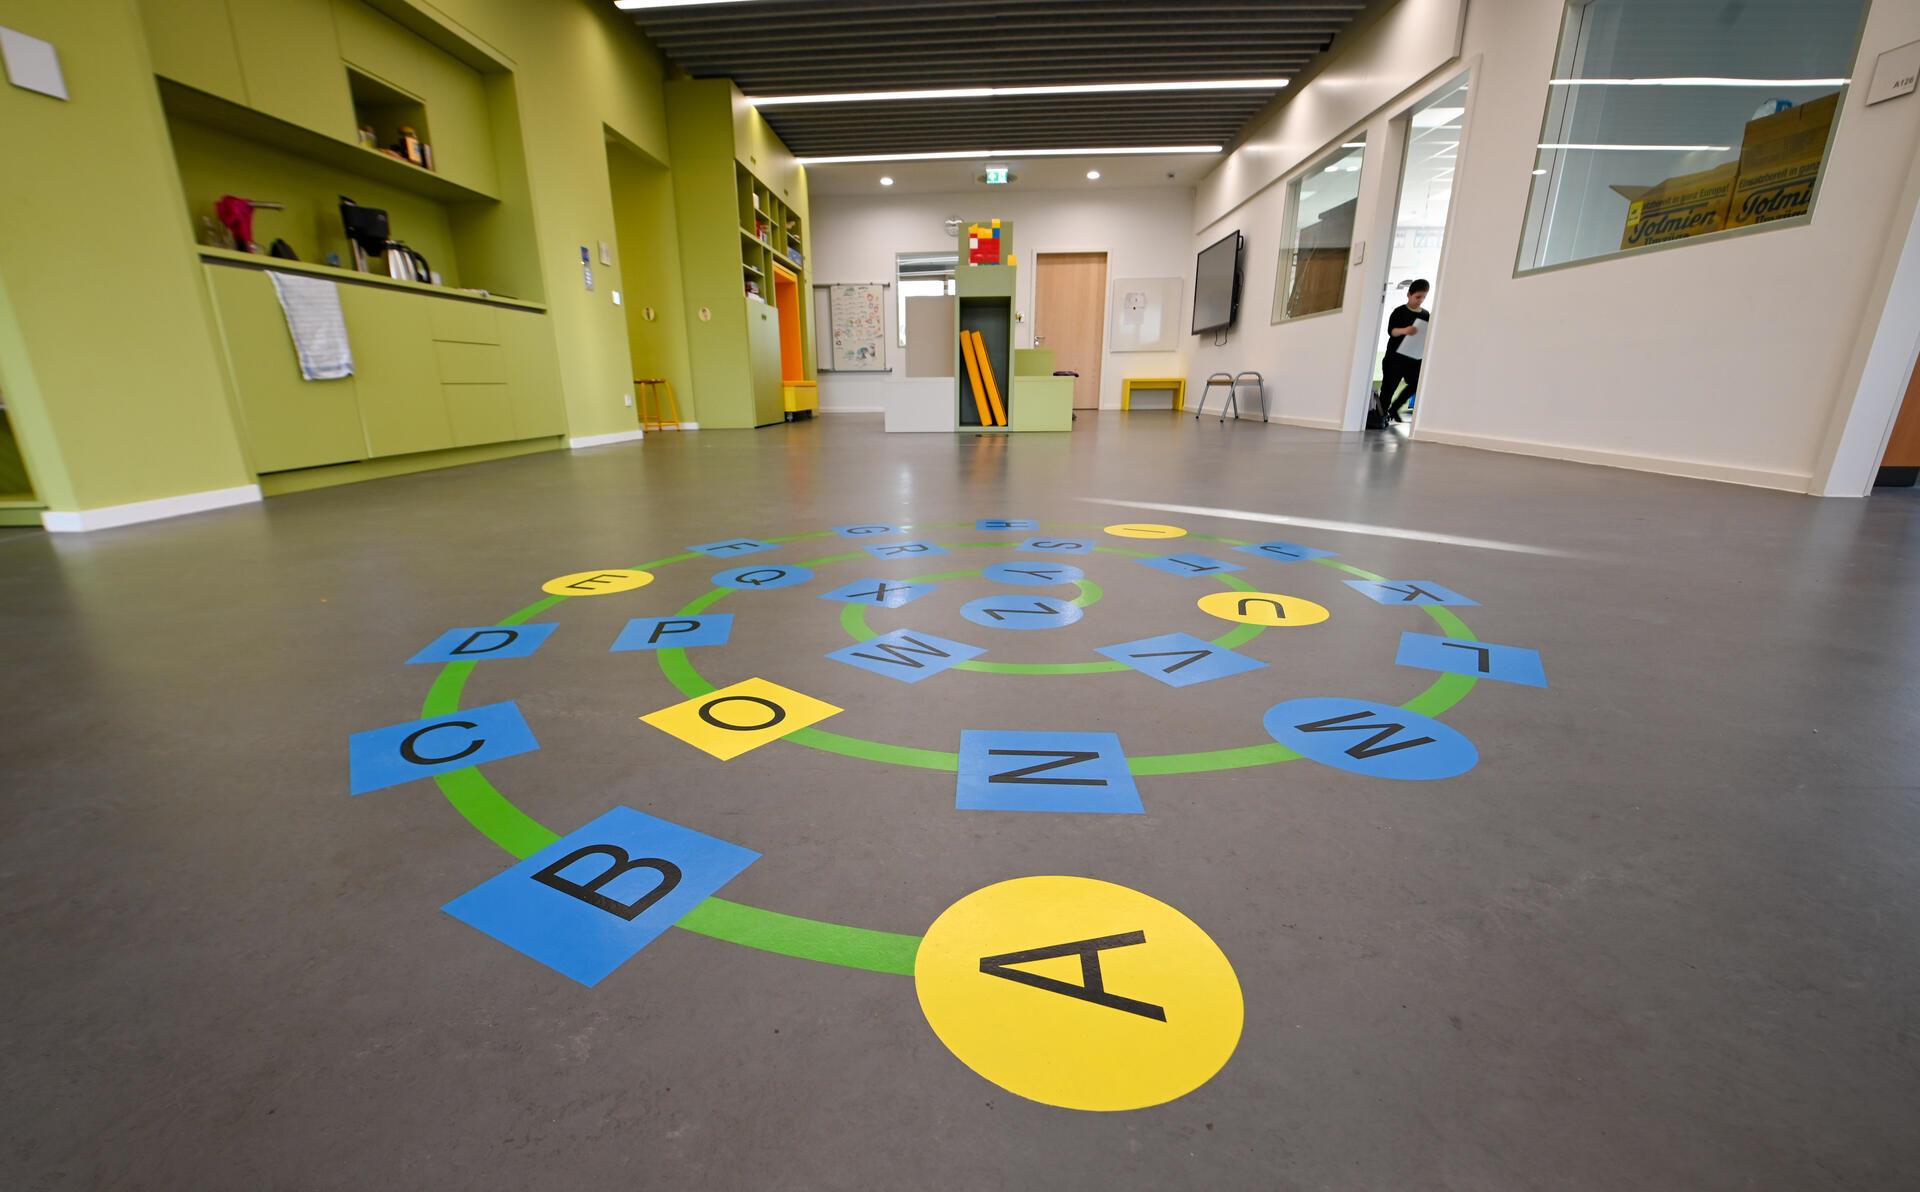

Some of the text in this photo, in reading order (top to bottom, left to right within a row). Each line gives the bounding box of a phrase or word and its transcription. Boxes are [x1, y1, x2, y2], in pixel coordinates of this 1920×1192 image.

[846, 526, 889, 534] G
[706, 542, 759, 551] F
[877, 544, 928, 556] R
[1032, 541, 1082, 549] S
[1260, 545, 1300, 557] J
[1003, 569, 1063, 581] Y
[1169, 558, 1220, 572] T
[566, 574, 628, 590] E
[736, 570, 786, 585] Q
[847, 583, 912, 601] X
[1377, 584, 1444, 601] K
[982, 601, 1060, 622] Z
[1238, 598, 1285, 620] U
[450, 630, 518, 654] D
[647, 620, 701, 643] P
[850, 635, 952, 669] W
[1129, 649, 1214, 674] V
[1442, 642, 1490, 673] L
[699, 696, 785, 731] O
[401, 721, 485, 765] C
[1295, 711, 1436, 759] M
[989, 750, 1107, 785] N
[531, 845, 682, 921] B
[980, 930, 1166, 1022] A
